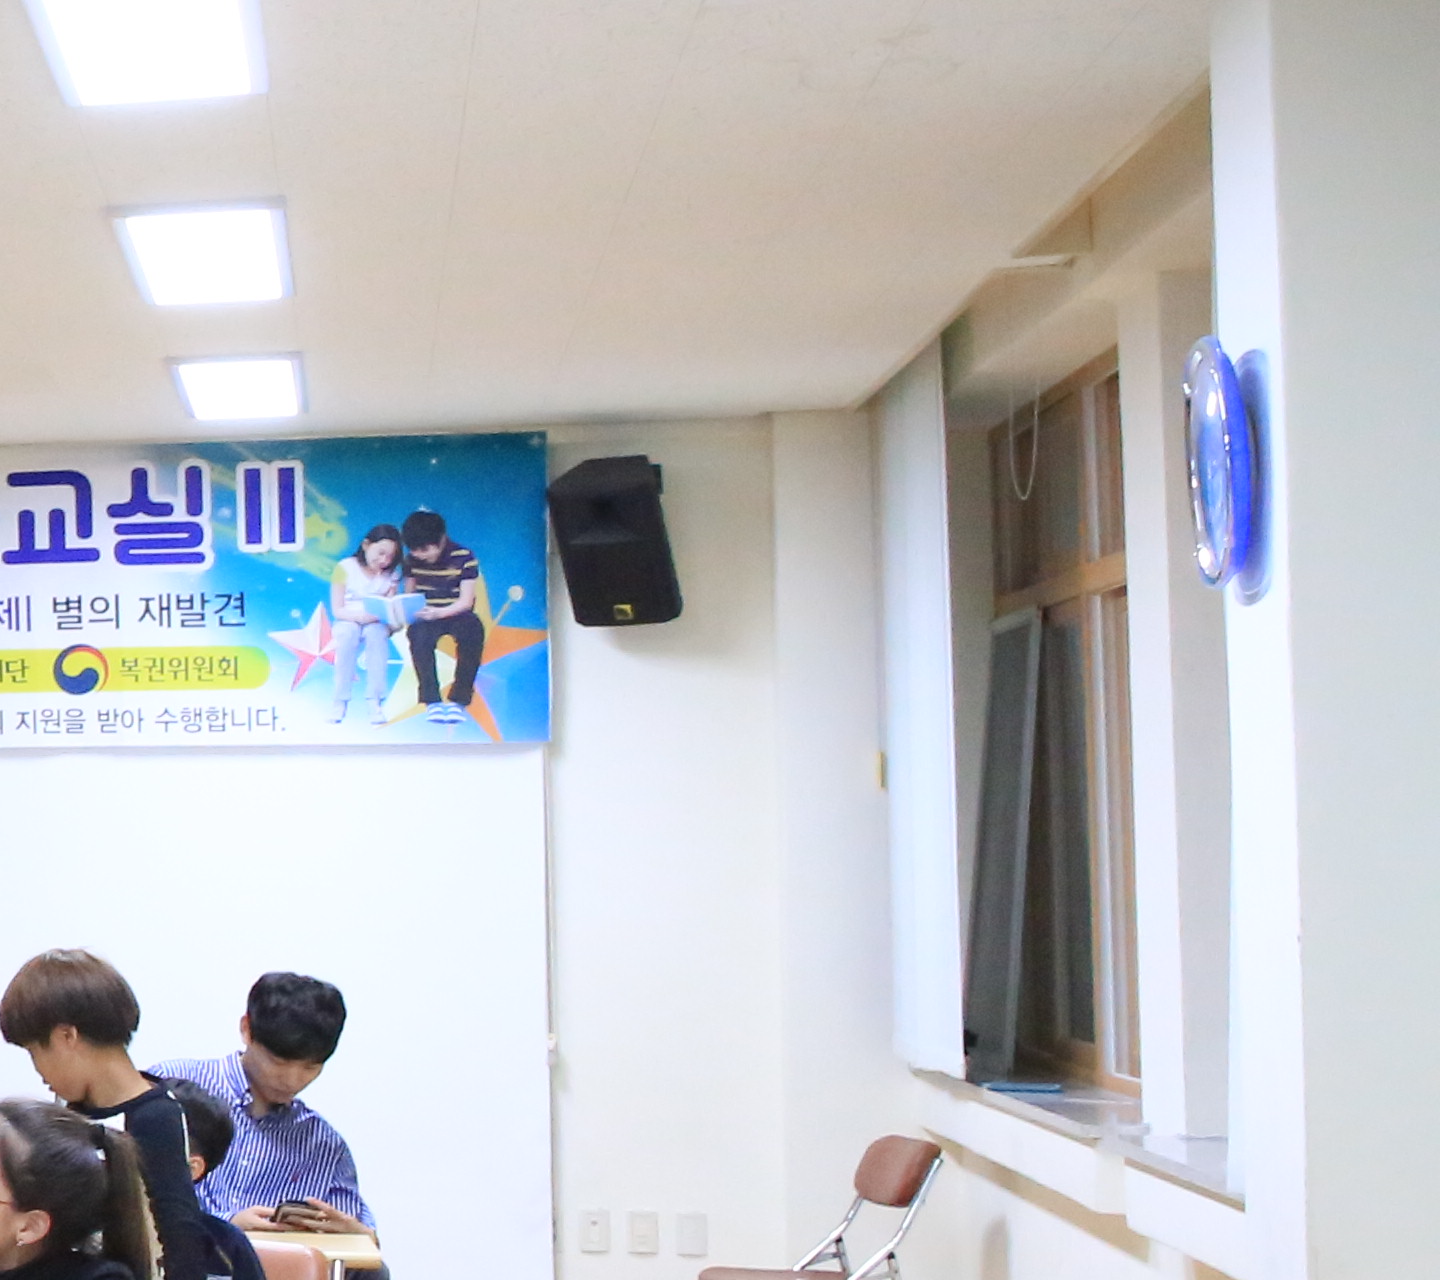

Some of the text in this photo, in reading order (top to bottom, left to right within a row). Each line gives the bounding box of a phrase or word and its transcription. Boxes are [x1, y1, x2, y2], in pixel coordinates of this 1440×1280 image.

[51, 593, 120, 631] 별의
[137, 591, 247, 630] 재발견
[119, 655, 240, 684] 복권위원회
[15, 707, 87, 735] 지원을
[97, 707, 144, 734] 받아
[154, 705, 287, 734] 수행합니다.
